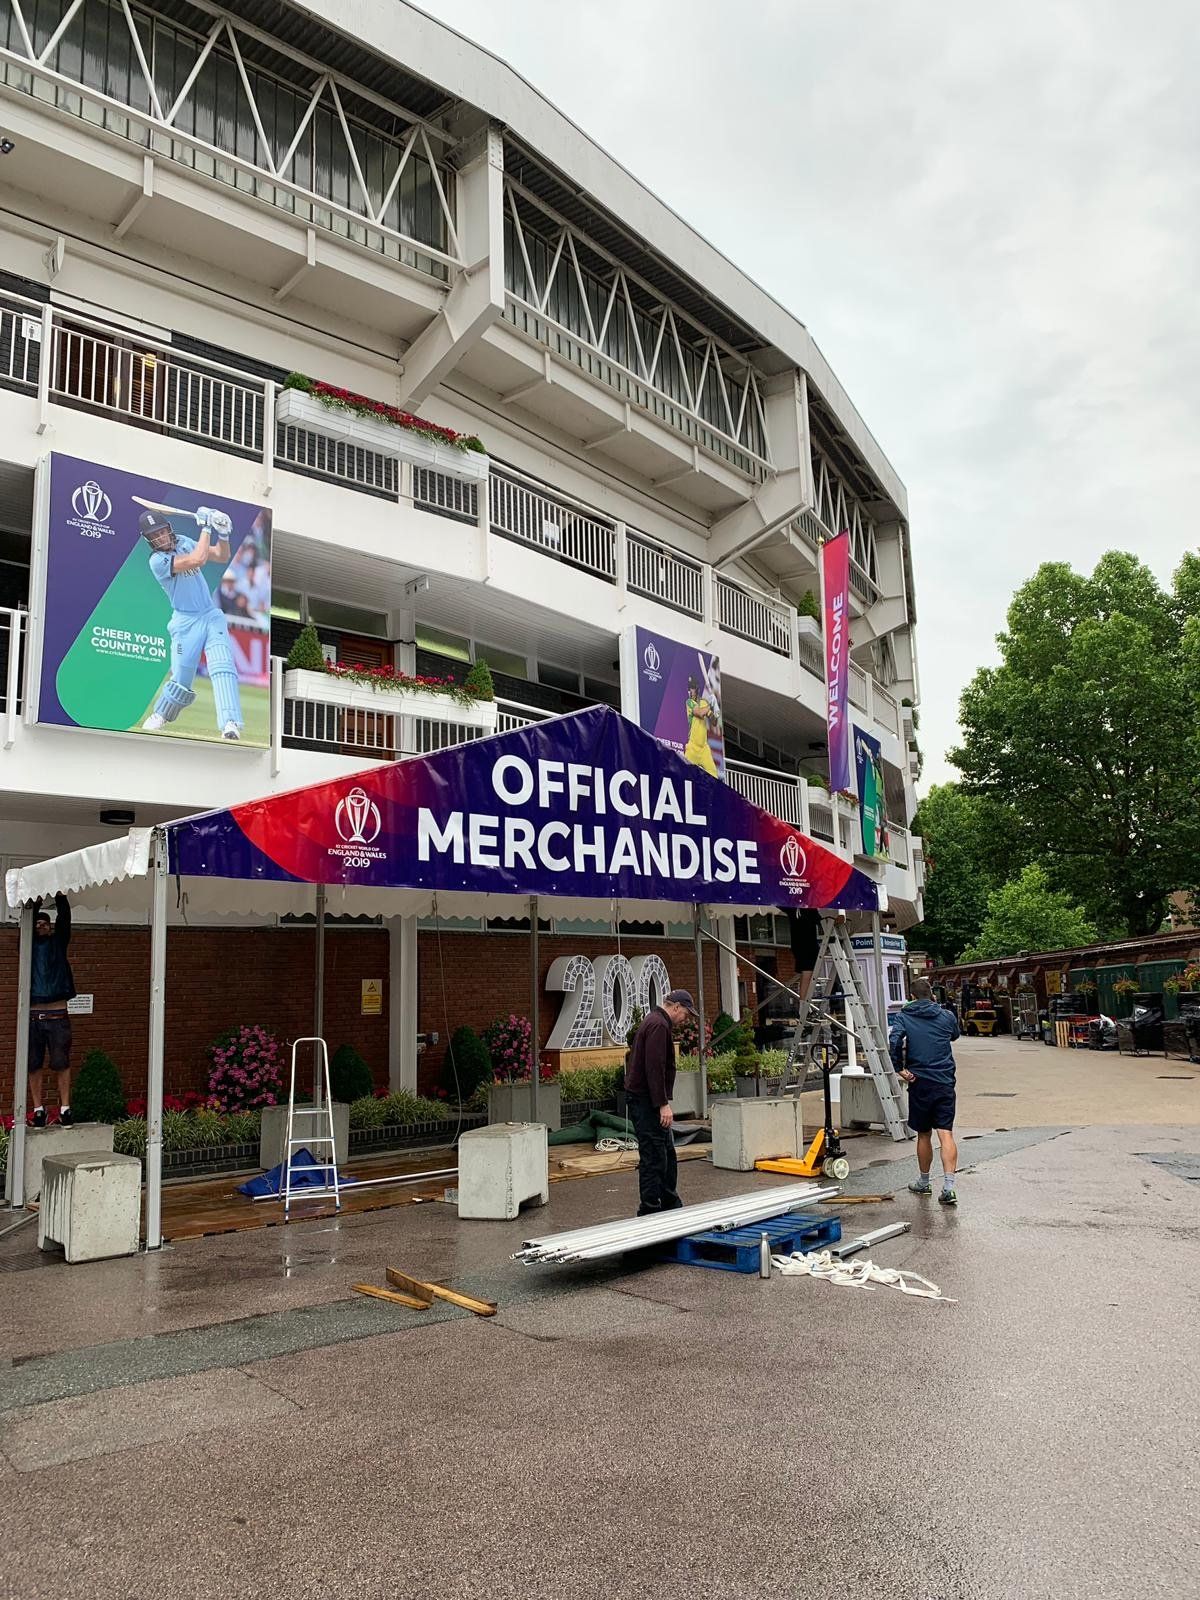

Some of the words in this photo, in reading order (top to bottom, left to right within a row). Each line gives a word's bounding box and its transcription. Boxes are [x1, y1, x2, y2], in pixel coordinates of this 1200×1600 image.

[66, 519, 93, 530] ENGLAND
[97, 526, 116, 535] WALES
[80, 527, 102, 539] 2019
[92, 626, 132, 642] CHEER
[134, 633, 165, 647] YOUR
[91, 637, 146, 655] COUNTRY
[148, 647, 167, 658] ON
[827, 591, 843, 731] WELCOME
[492, 754, 707, 826] OFFICIAL
[328, 849, 360, 857] ENGLAND
[360, 850, 365, 858] &
[365, 851, 387, 859] WALES
[418, 807, 761, 884] MERCHANDISE
[344, 857, 370, 868] 2019
[545, 954, 671, 1050] 200
